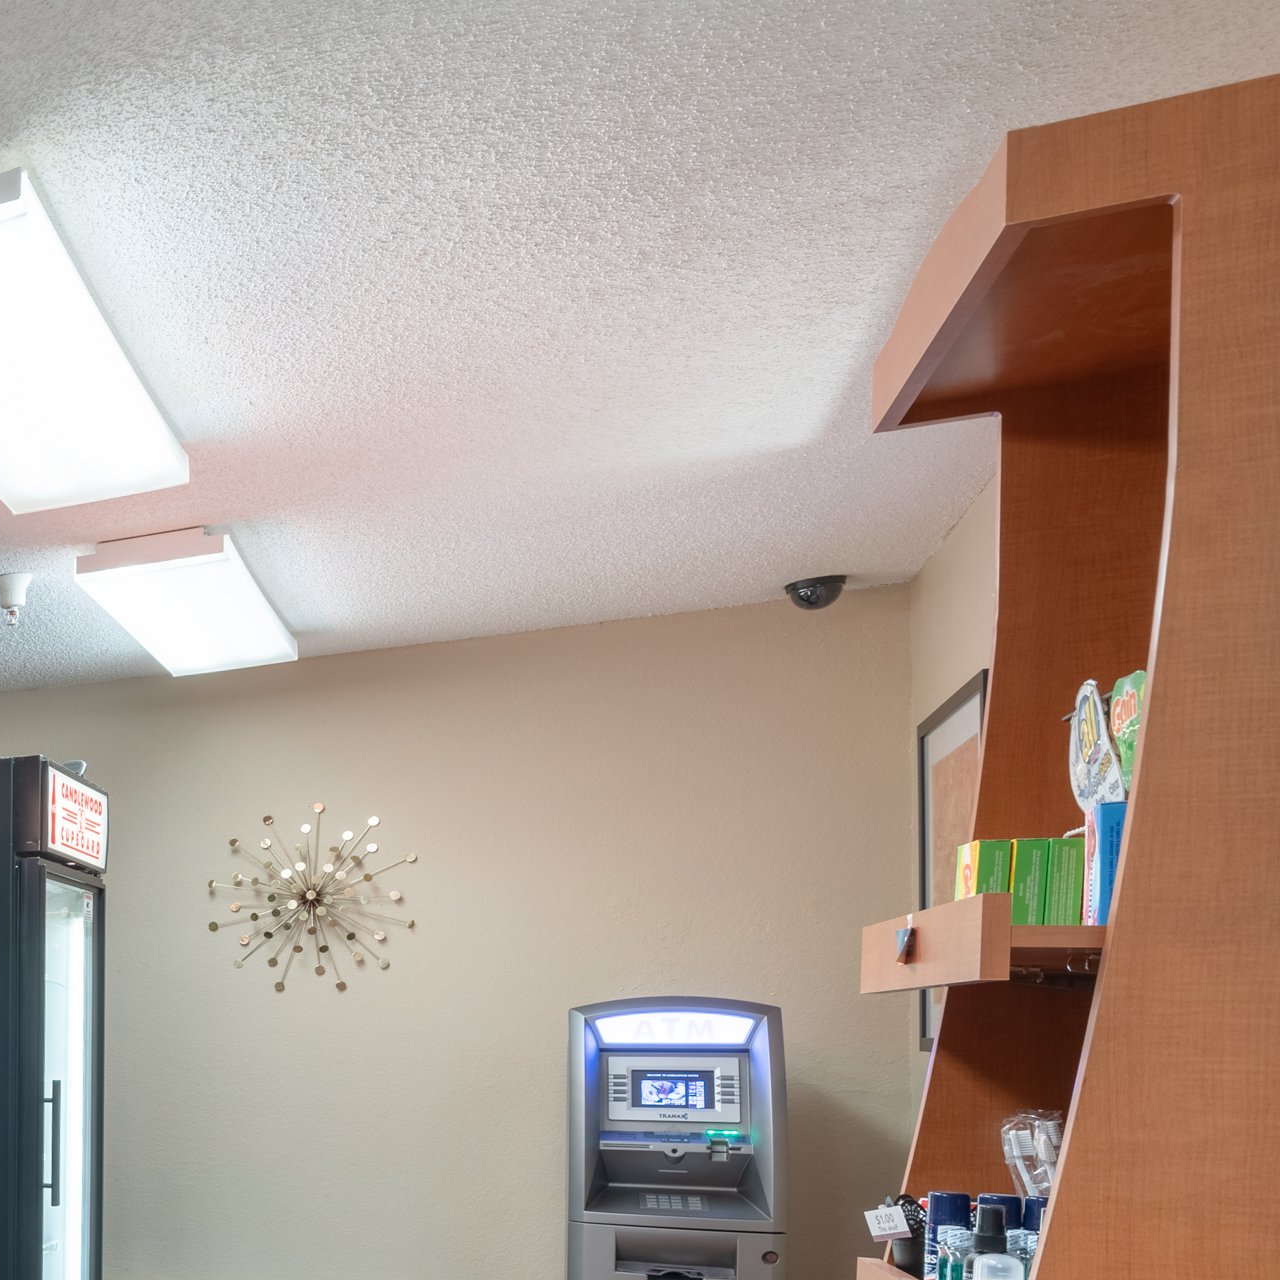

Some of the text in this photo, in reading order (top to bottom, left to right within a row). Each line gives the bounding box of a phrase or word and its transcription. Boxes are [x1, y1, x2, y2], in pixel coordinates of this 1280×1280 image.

[61, 782, 103, 816] CANDLEWOOD
[61, 827, 100, 855] CUPBOARD
[875, 1212, 895, 1226] $1.00
